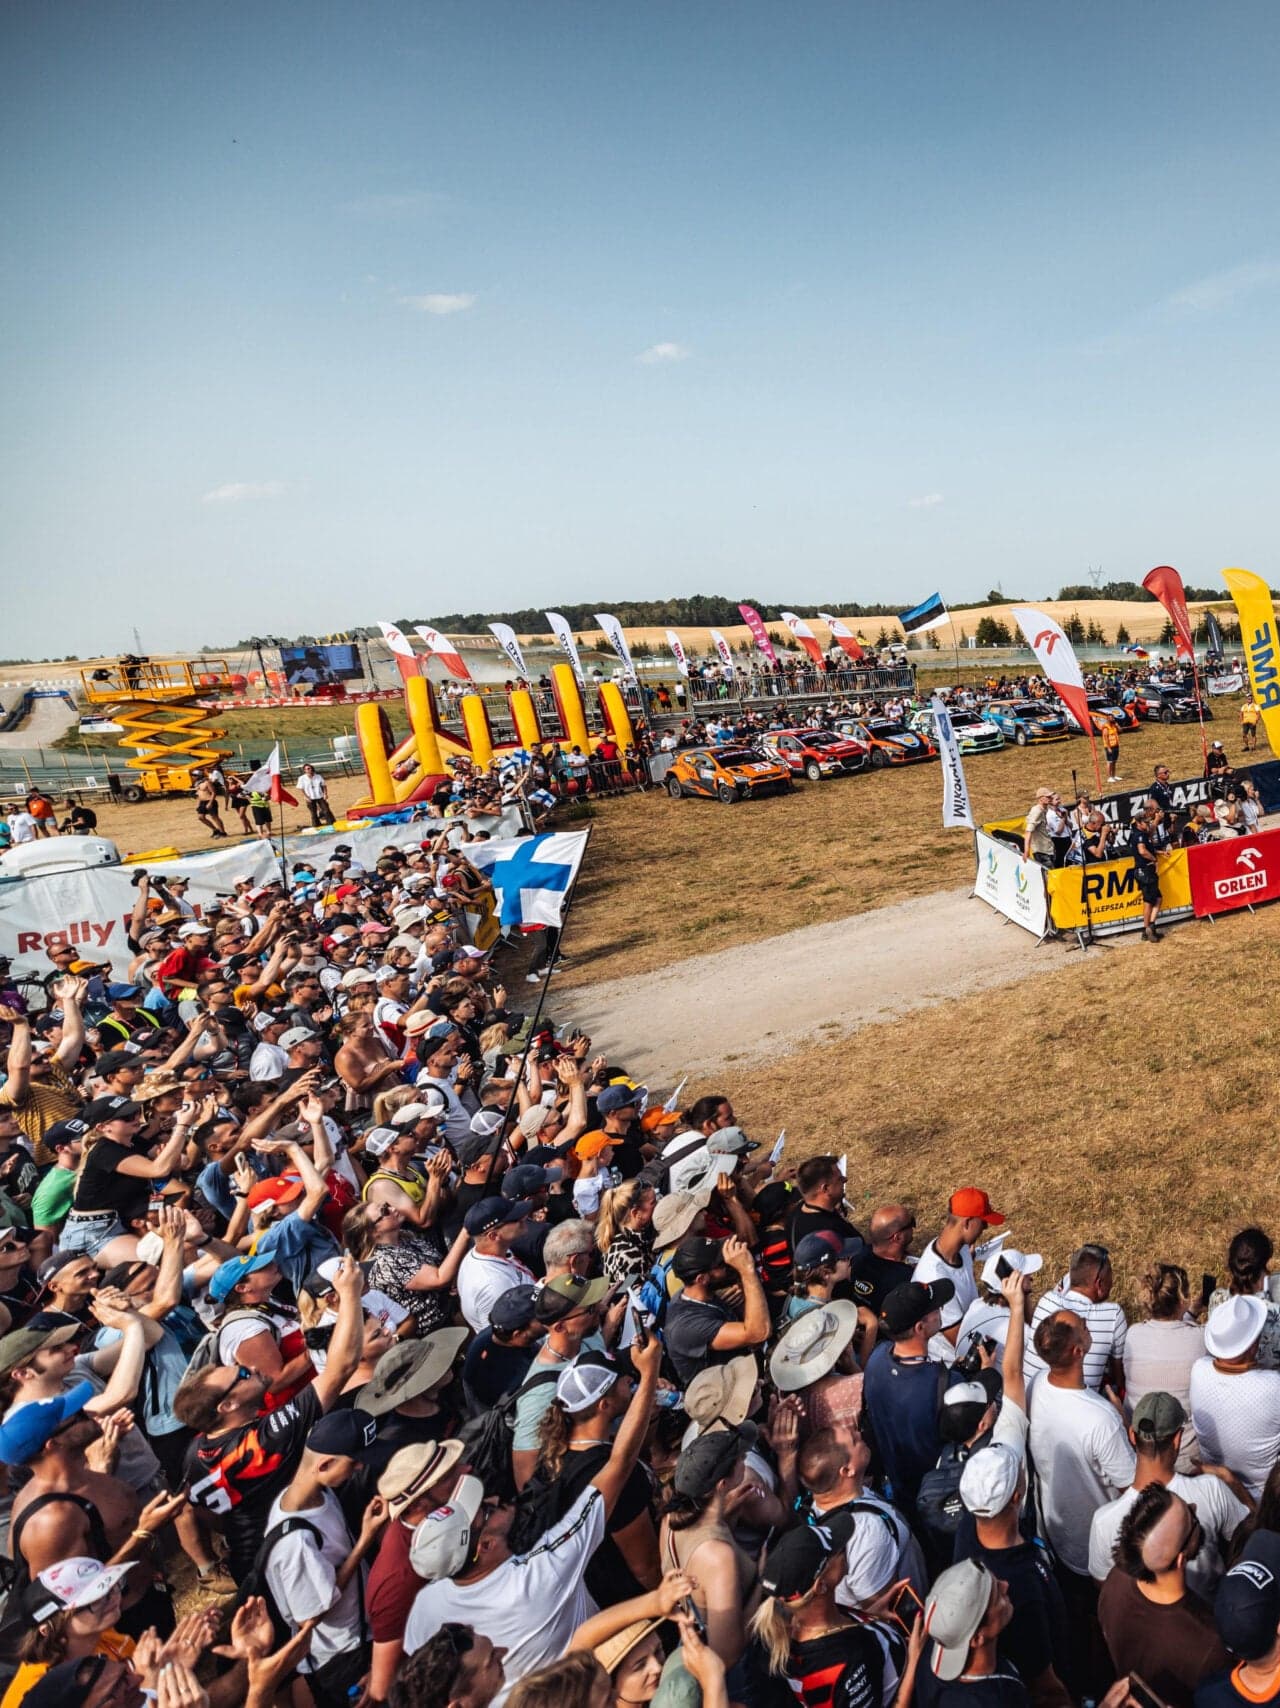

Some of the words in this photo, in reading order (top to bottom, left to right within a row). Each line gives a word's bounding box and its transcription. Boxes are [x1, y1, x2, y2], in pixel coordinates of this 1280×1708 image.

[1218, 873, 1264, 895] ORLEN
[1126, 898, 1142, 908] MUZ
[17, 919, 116, 953] Rally
